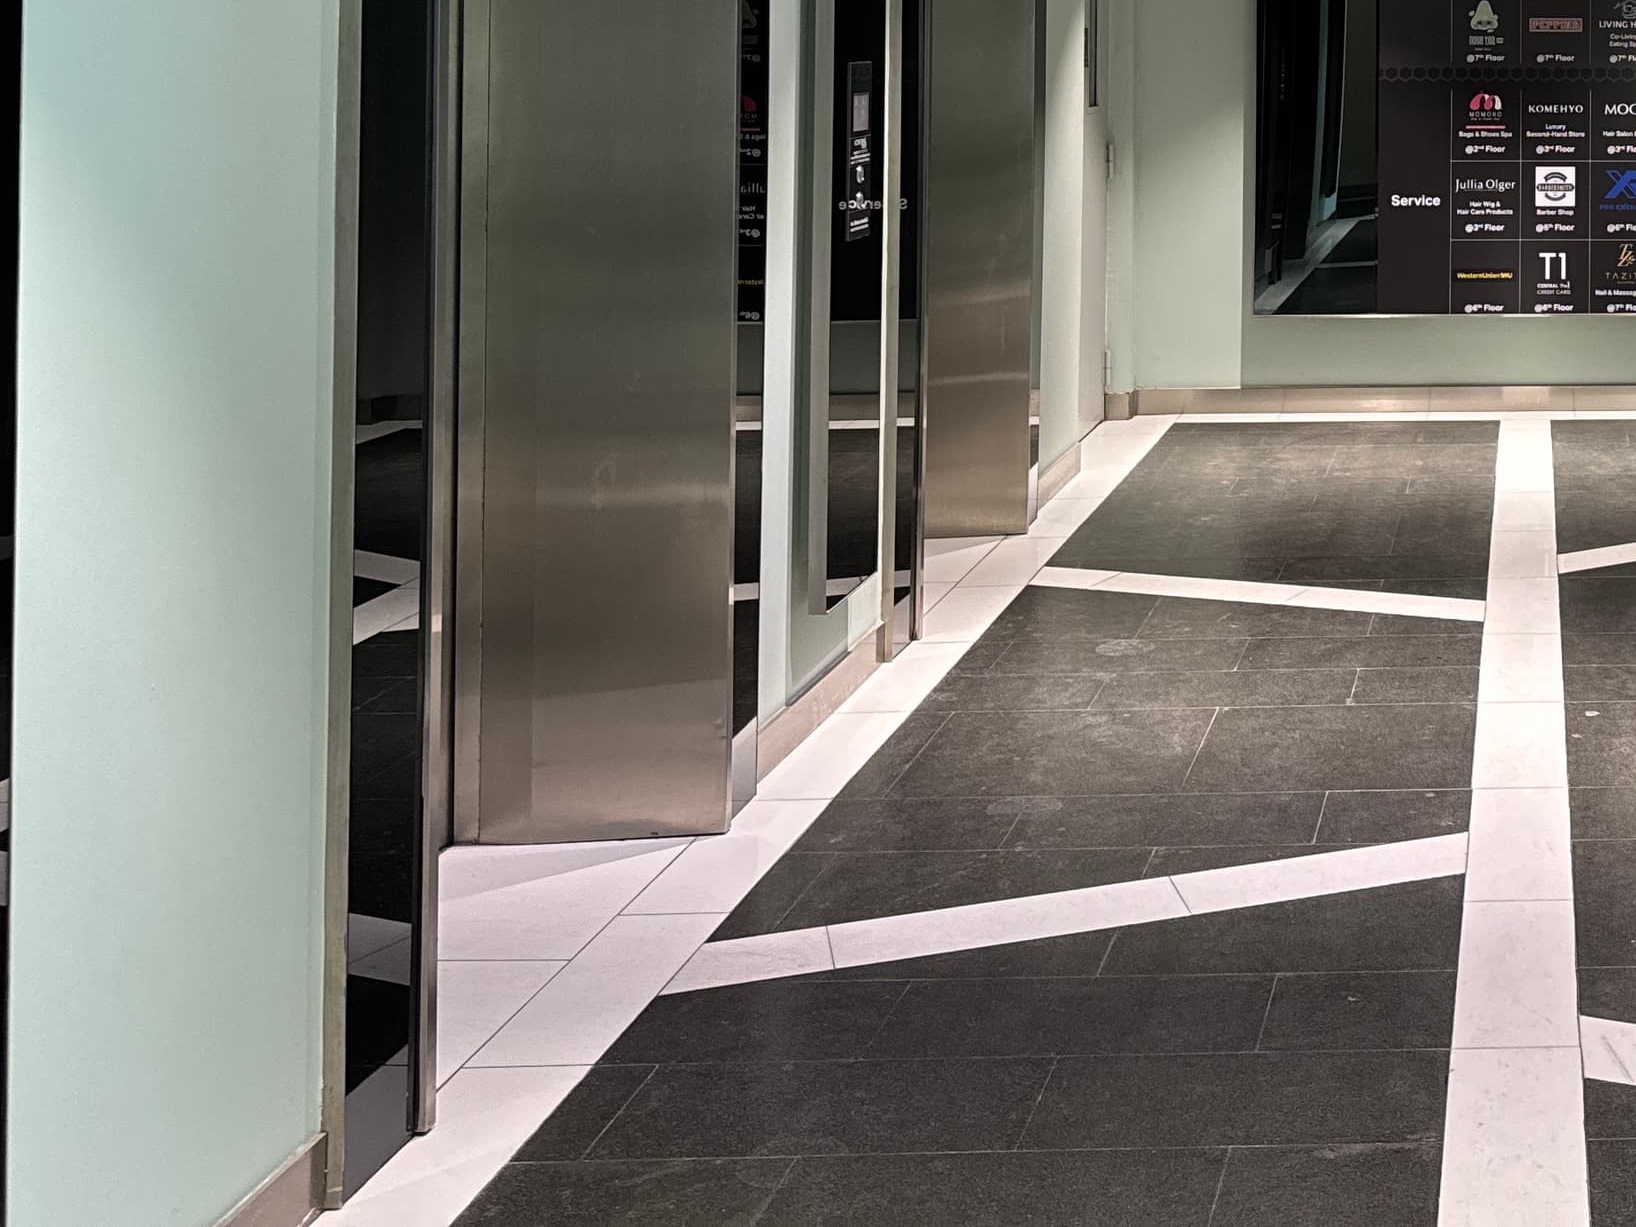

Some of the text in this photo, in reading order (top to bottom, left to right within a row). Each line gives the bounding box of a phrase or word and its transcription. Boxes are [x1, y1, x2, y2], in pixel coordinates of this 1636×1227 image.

[1599, 21, 1628, 29] LIVING
[1528, 105, 1583, 113] KOMEHYO
[1456, 179, 1516, 192] Jullia Olger
[1391, 195, 1441, 207] Service
[1539, 253, 1566, 280] T1
